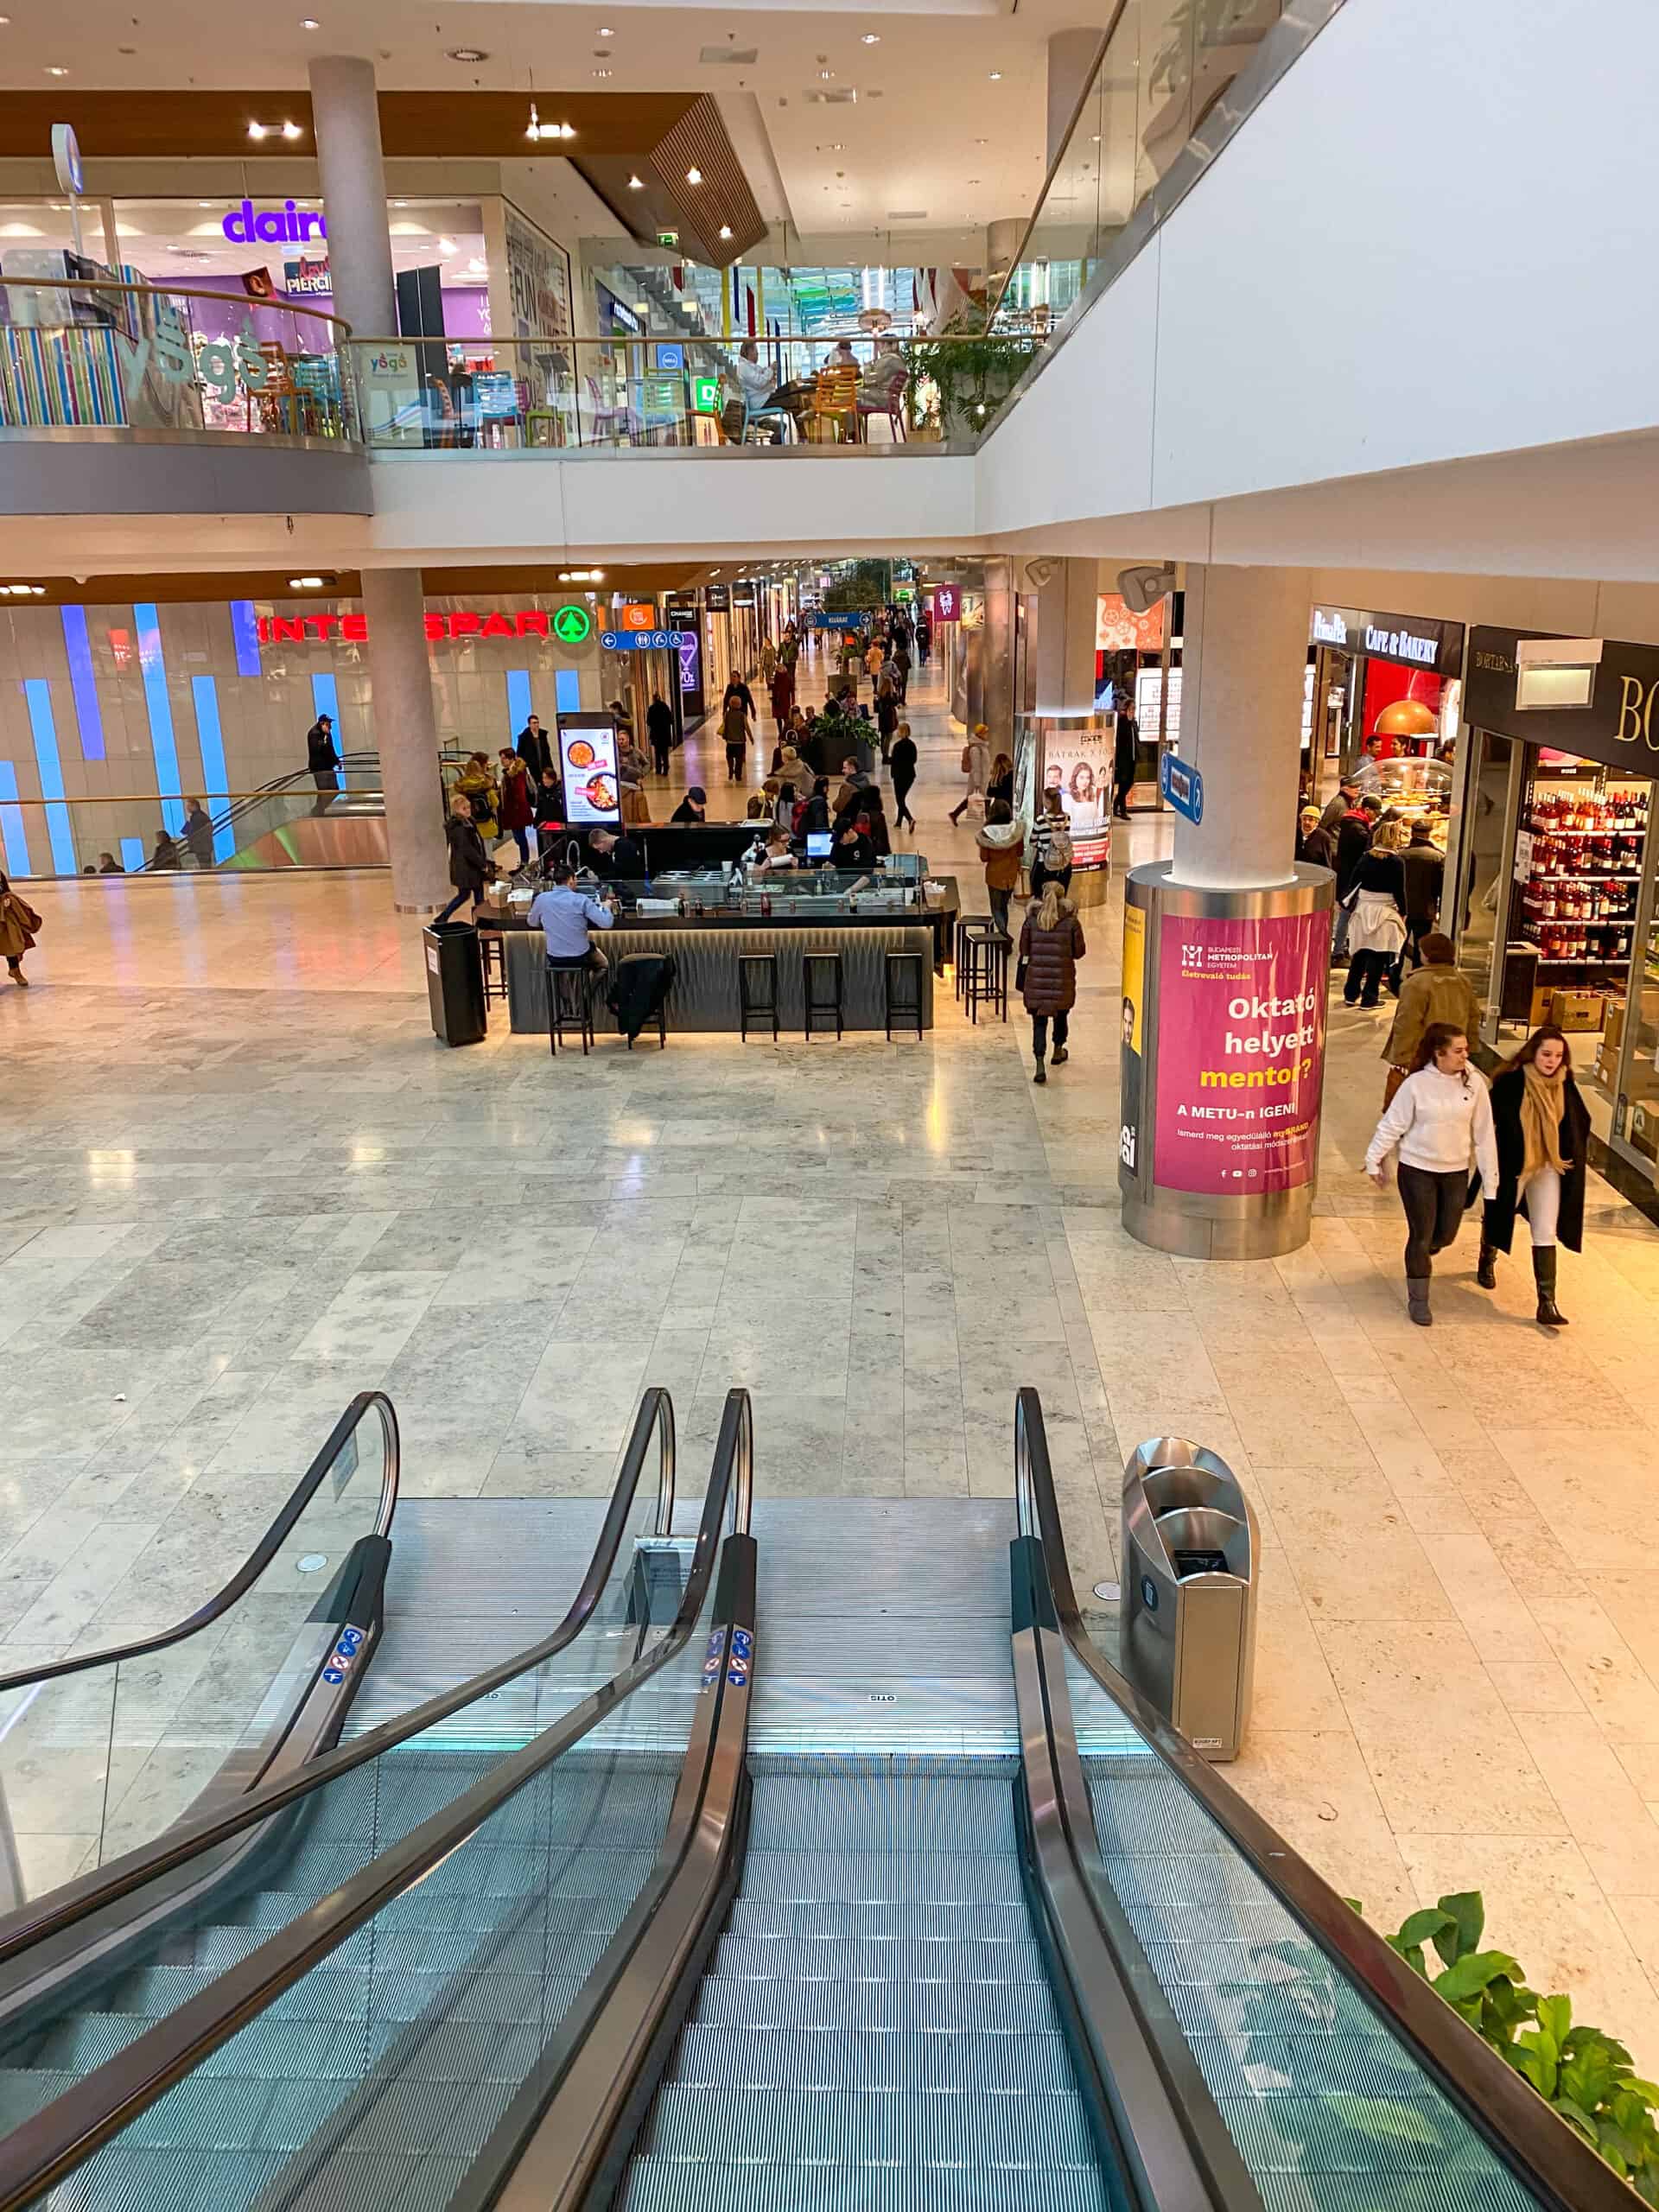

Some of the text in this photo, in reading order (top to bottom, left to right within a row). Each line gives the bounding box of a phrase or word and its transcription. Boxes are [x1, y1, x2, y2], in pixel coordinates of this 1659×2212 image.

[287, 276, 333, 292] PIERCI
[257, 609, 548, 643] INTESPAR
[1365, 625, 1439, 664] CAFE & BAKERY
[1228, 988, 1314, 1020] Oktató
[1224, 1023, 1314, 1058] helyett
[1200, 1058, 1313, 1089] mentor?
[1177, 1104, 1187, 1116] A
[1206, 1132, 1224, 1141] meg
